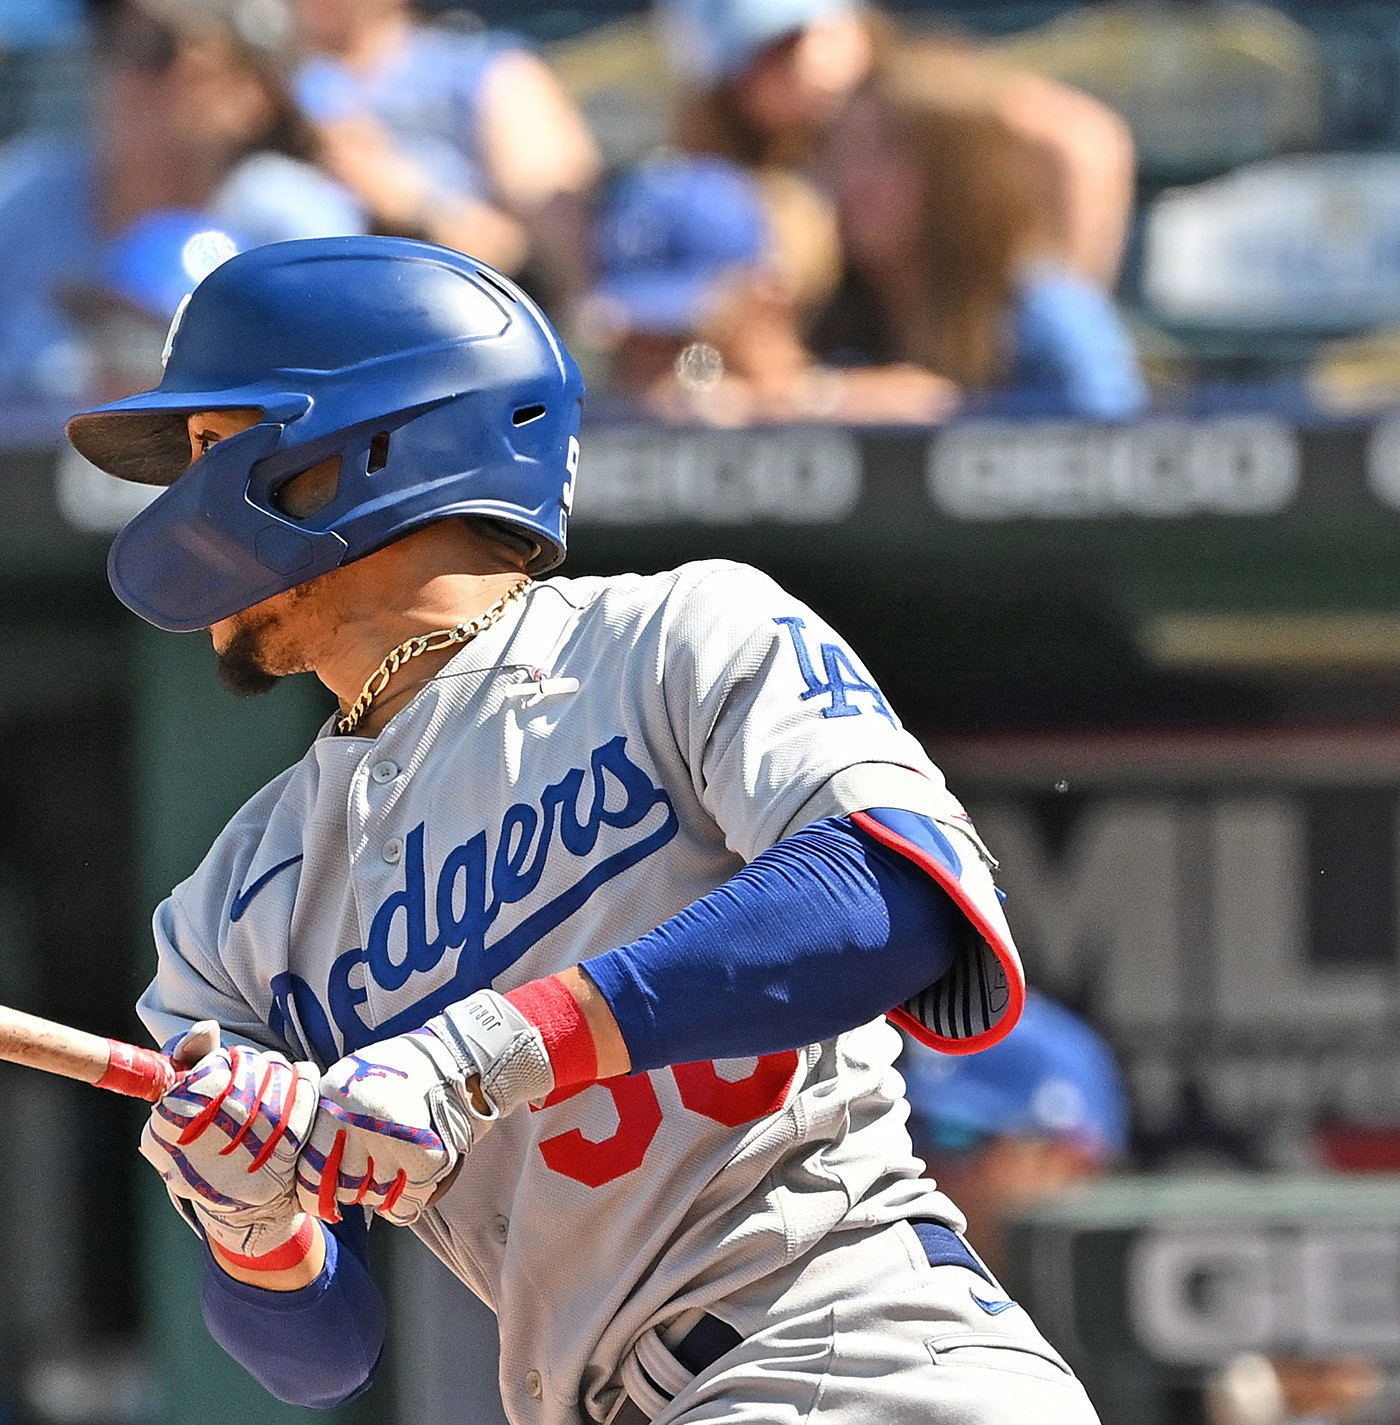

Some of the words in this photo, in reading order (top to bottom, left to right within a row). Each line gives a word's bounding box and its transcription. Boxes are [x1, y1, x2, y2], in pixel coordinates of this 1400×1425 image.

[570, 428, 863, 523] EICO
[928, 419, 1299, 516] GEICO
[772, 616, 898, 731] LA
[464, 1001, 502, 1031] JORD
